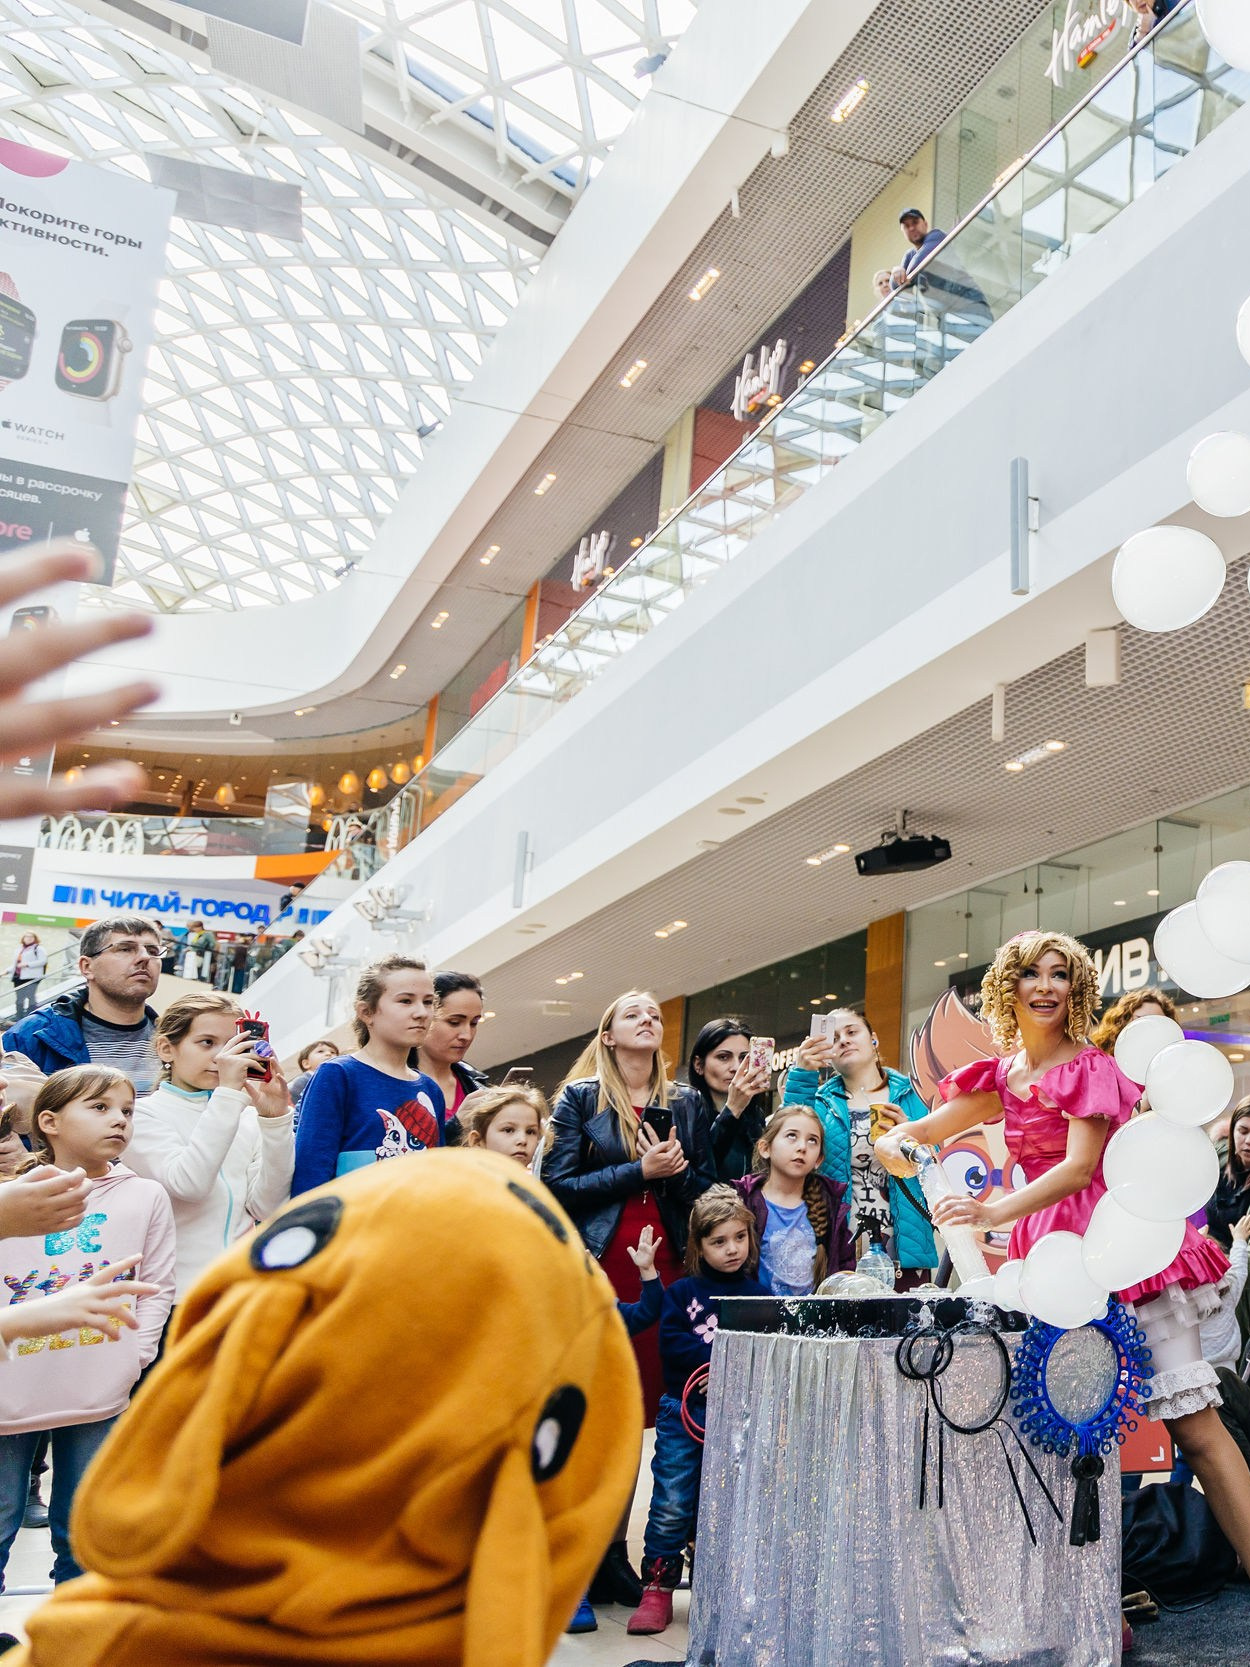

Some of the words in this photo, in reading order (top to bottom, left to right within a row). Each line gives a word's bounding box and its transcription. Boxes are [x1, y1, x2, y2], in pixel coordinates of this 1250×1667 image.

[94, 228, 142, 249] горы
[14, 422, 65, 441] WATCH
[0, 473, 13, 484] ы
[16, 476, 25, 485] в
[27, 478, 103, 502] рассрочку
[100, 889, 271, 926] ЧИТАЙ-ГОРОД
[1094, 937, 1150, 997] ИВ
